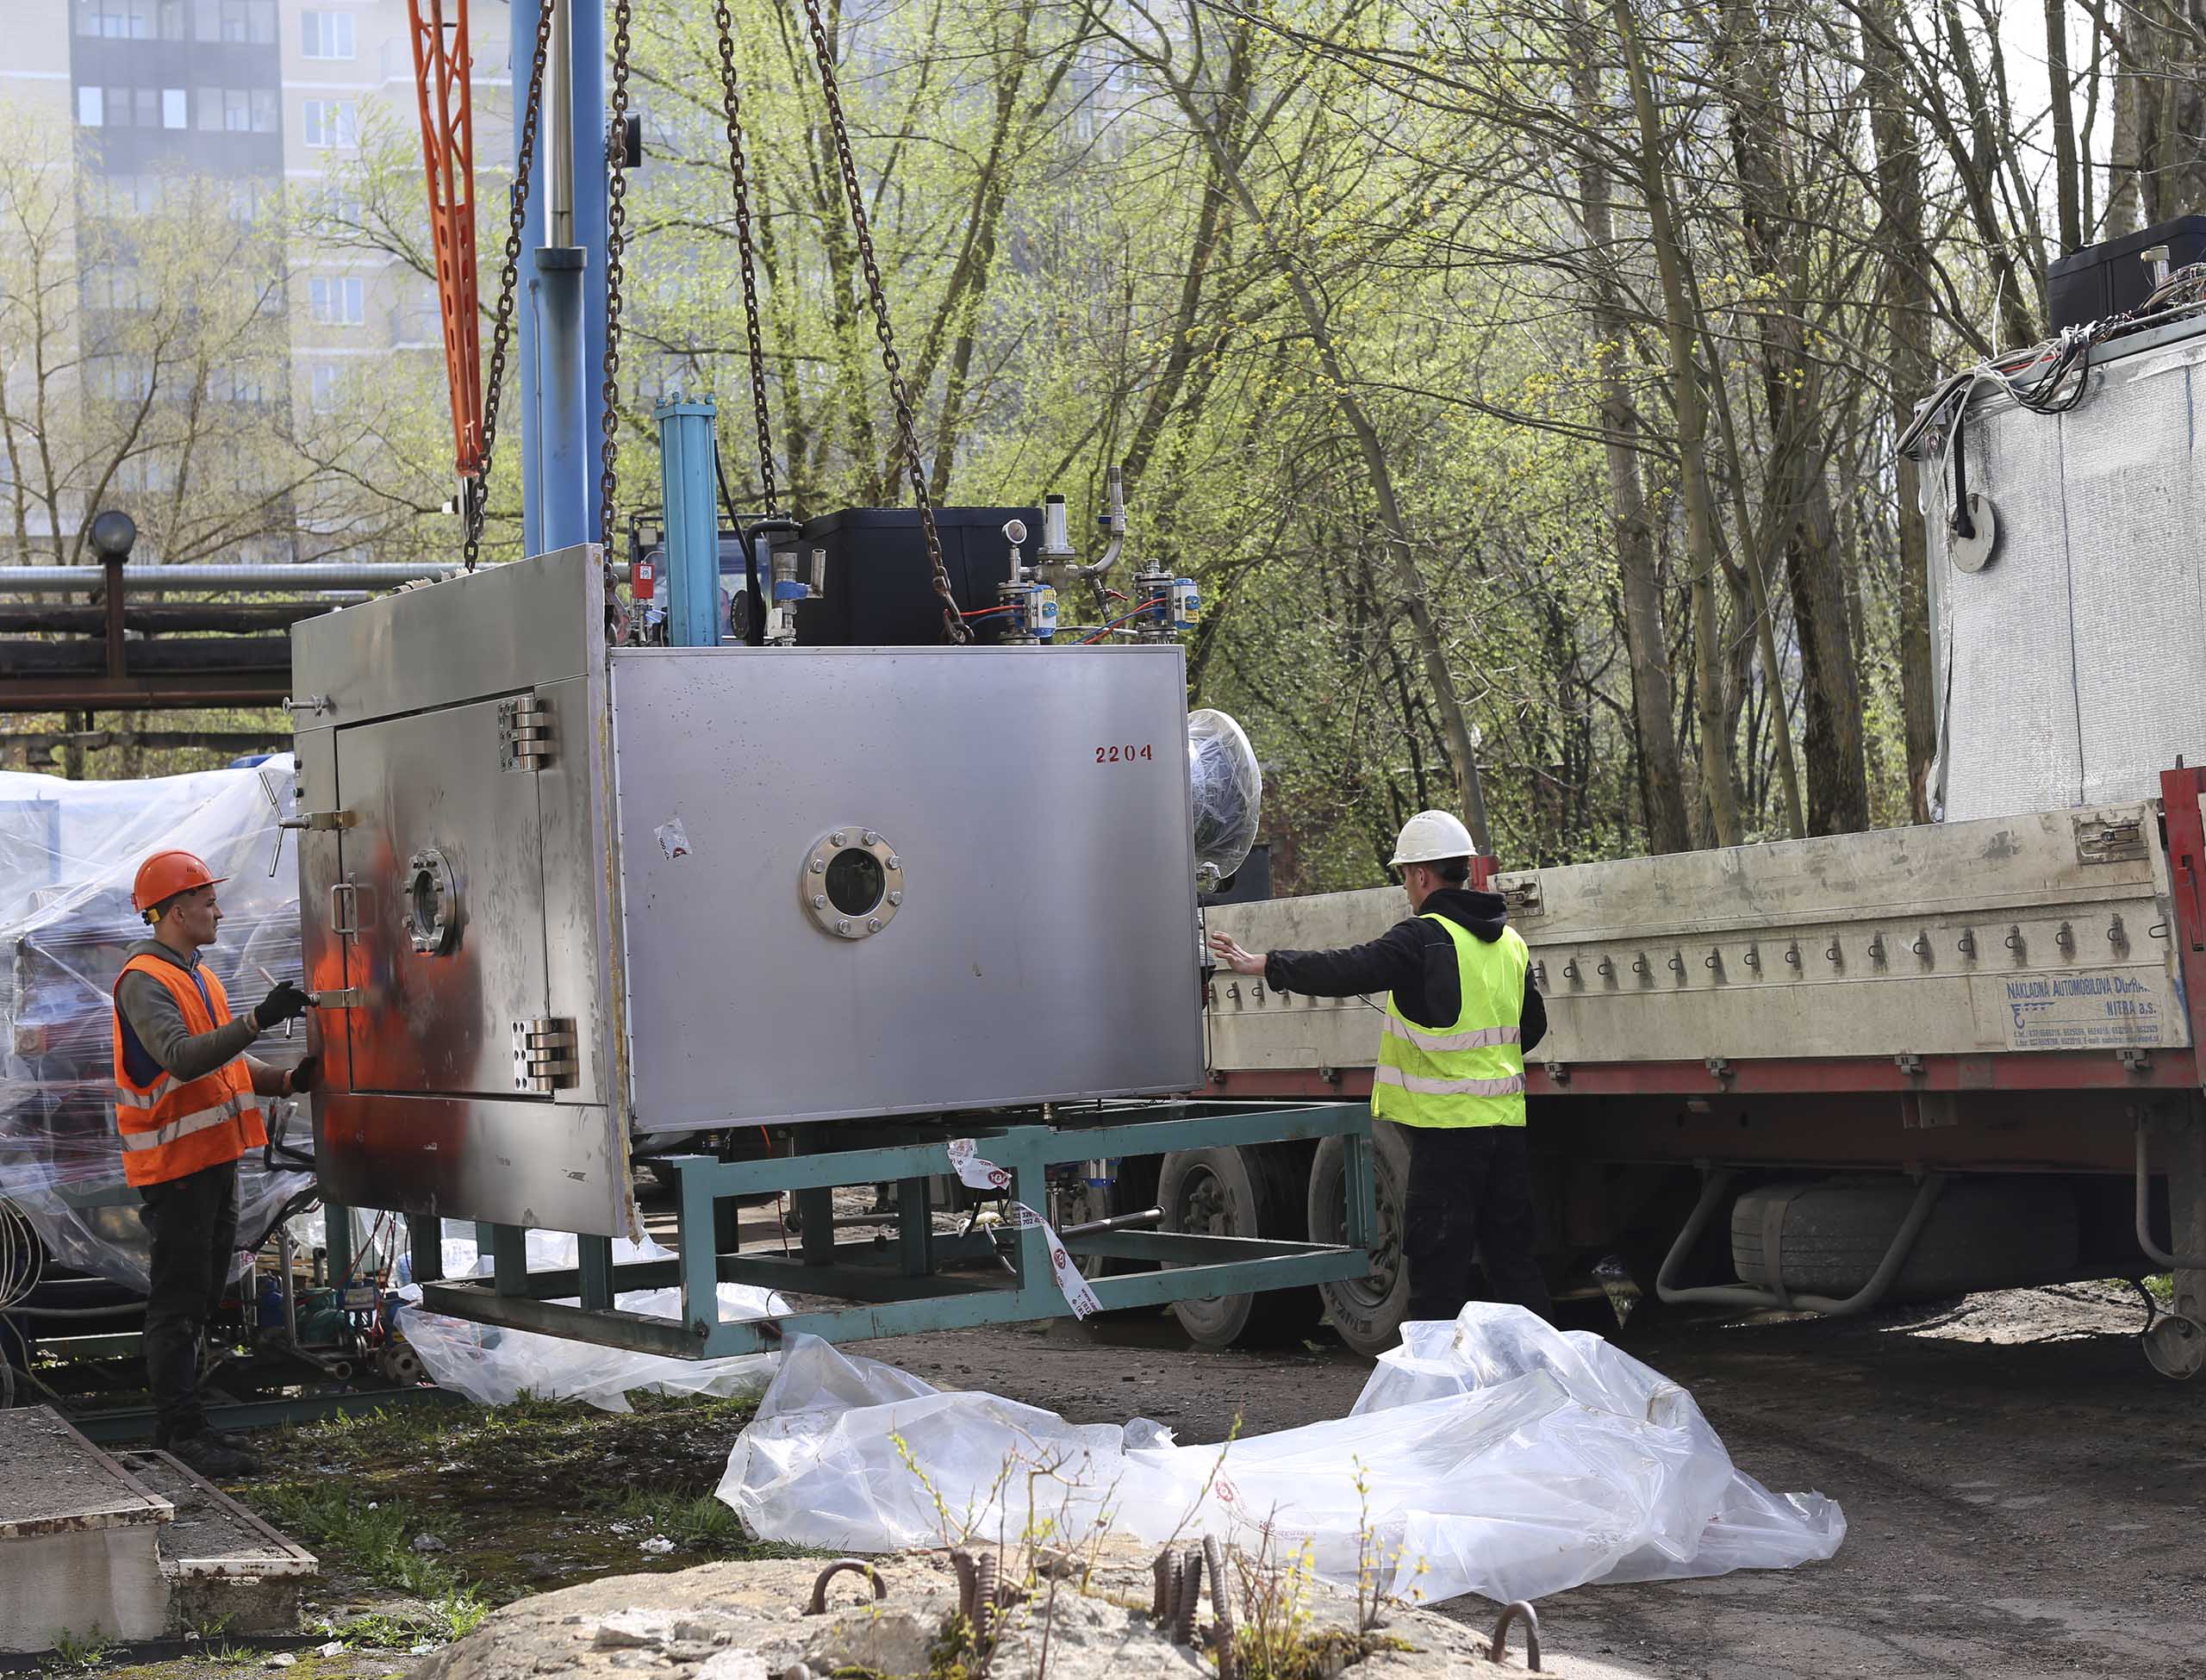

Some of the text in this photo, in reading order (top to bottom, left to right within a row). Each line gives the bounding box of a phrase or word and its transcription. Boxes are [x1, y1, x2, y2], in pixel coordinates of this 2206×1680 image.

[1095, 744, 1152, 763] 2204
[2106, 1000, 2157, 1017] NITRA a.s.
